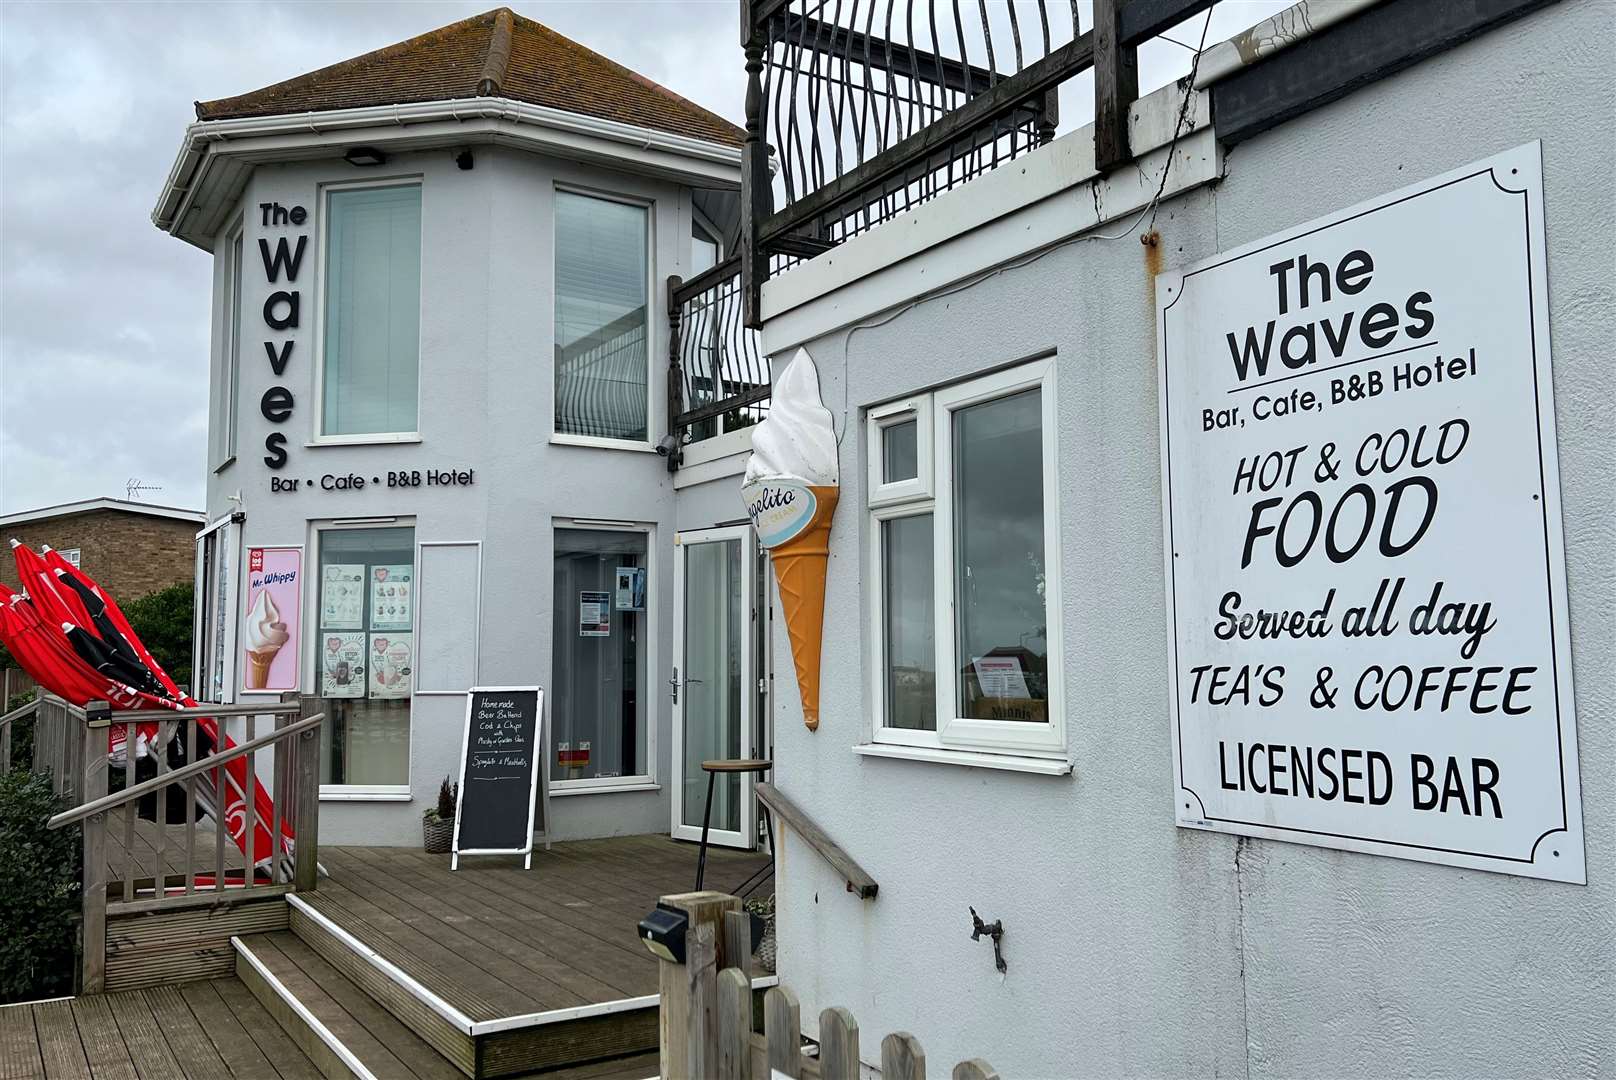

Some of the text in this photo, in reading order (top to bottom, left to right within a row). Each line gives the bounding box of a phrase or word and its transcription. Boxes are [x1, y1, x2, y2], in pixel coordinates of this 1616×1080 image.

[259, 201, 308, 227] The
[1269, 249, 1374, 316] The
[257, 235, 308, 470] Waves
[1226, 291, 1436, 382] Waves
[1202, 347, 1477, 433] Bar, Cafe, B&B Hotel
[271, 468, 475, 493] Bar Cafe B&B Hotel
[1232, 418, 1471, 497] HOT & COLD
[1240, 475, 1439, 571] FOOD
[264, 570, 297, 585] Whippy
[1213, 577, 1498, 660] Served all day
[1189, 664, 1538, 716] TEA'S & COFFEE
[1218, 741, 1504, 819] LICENSED BAR
